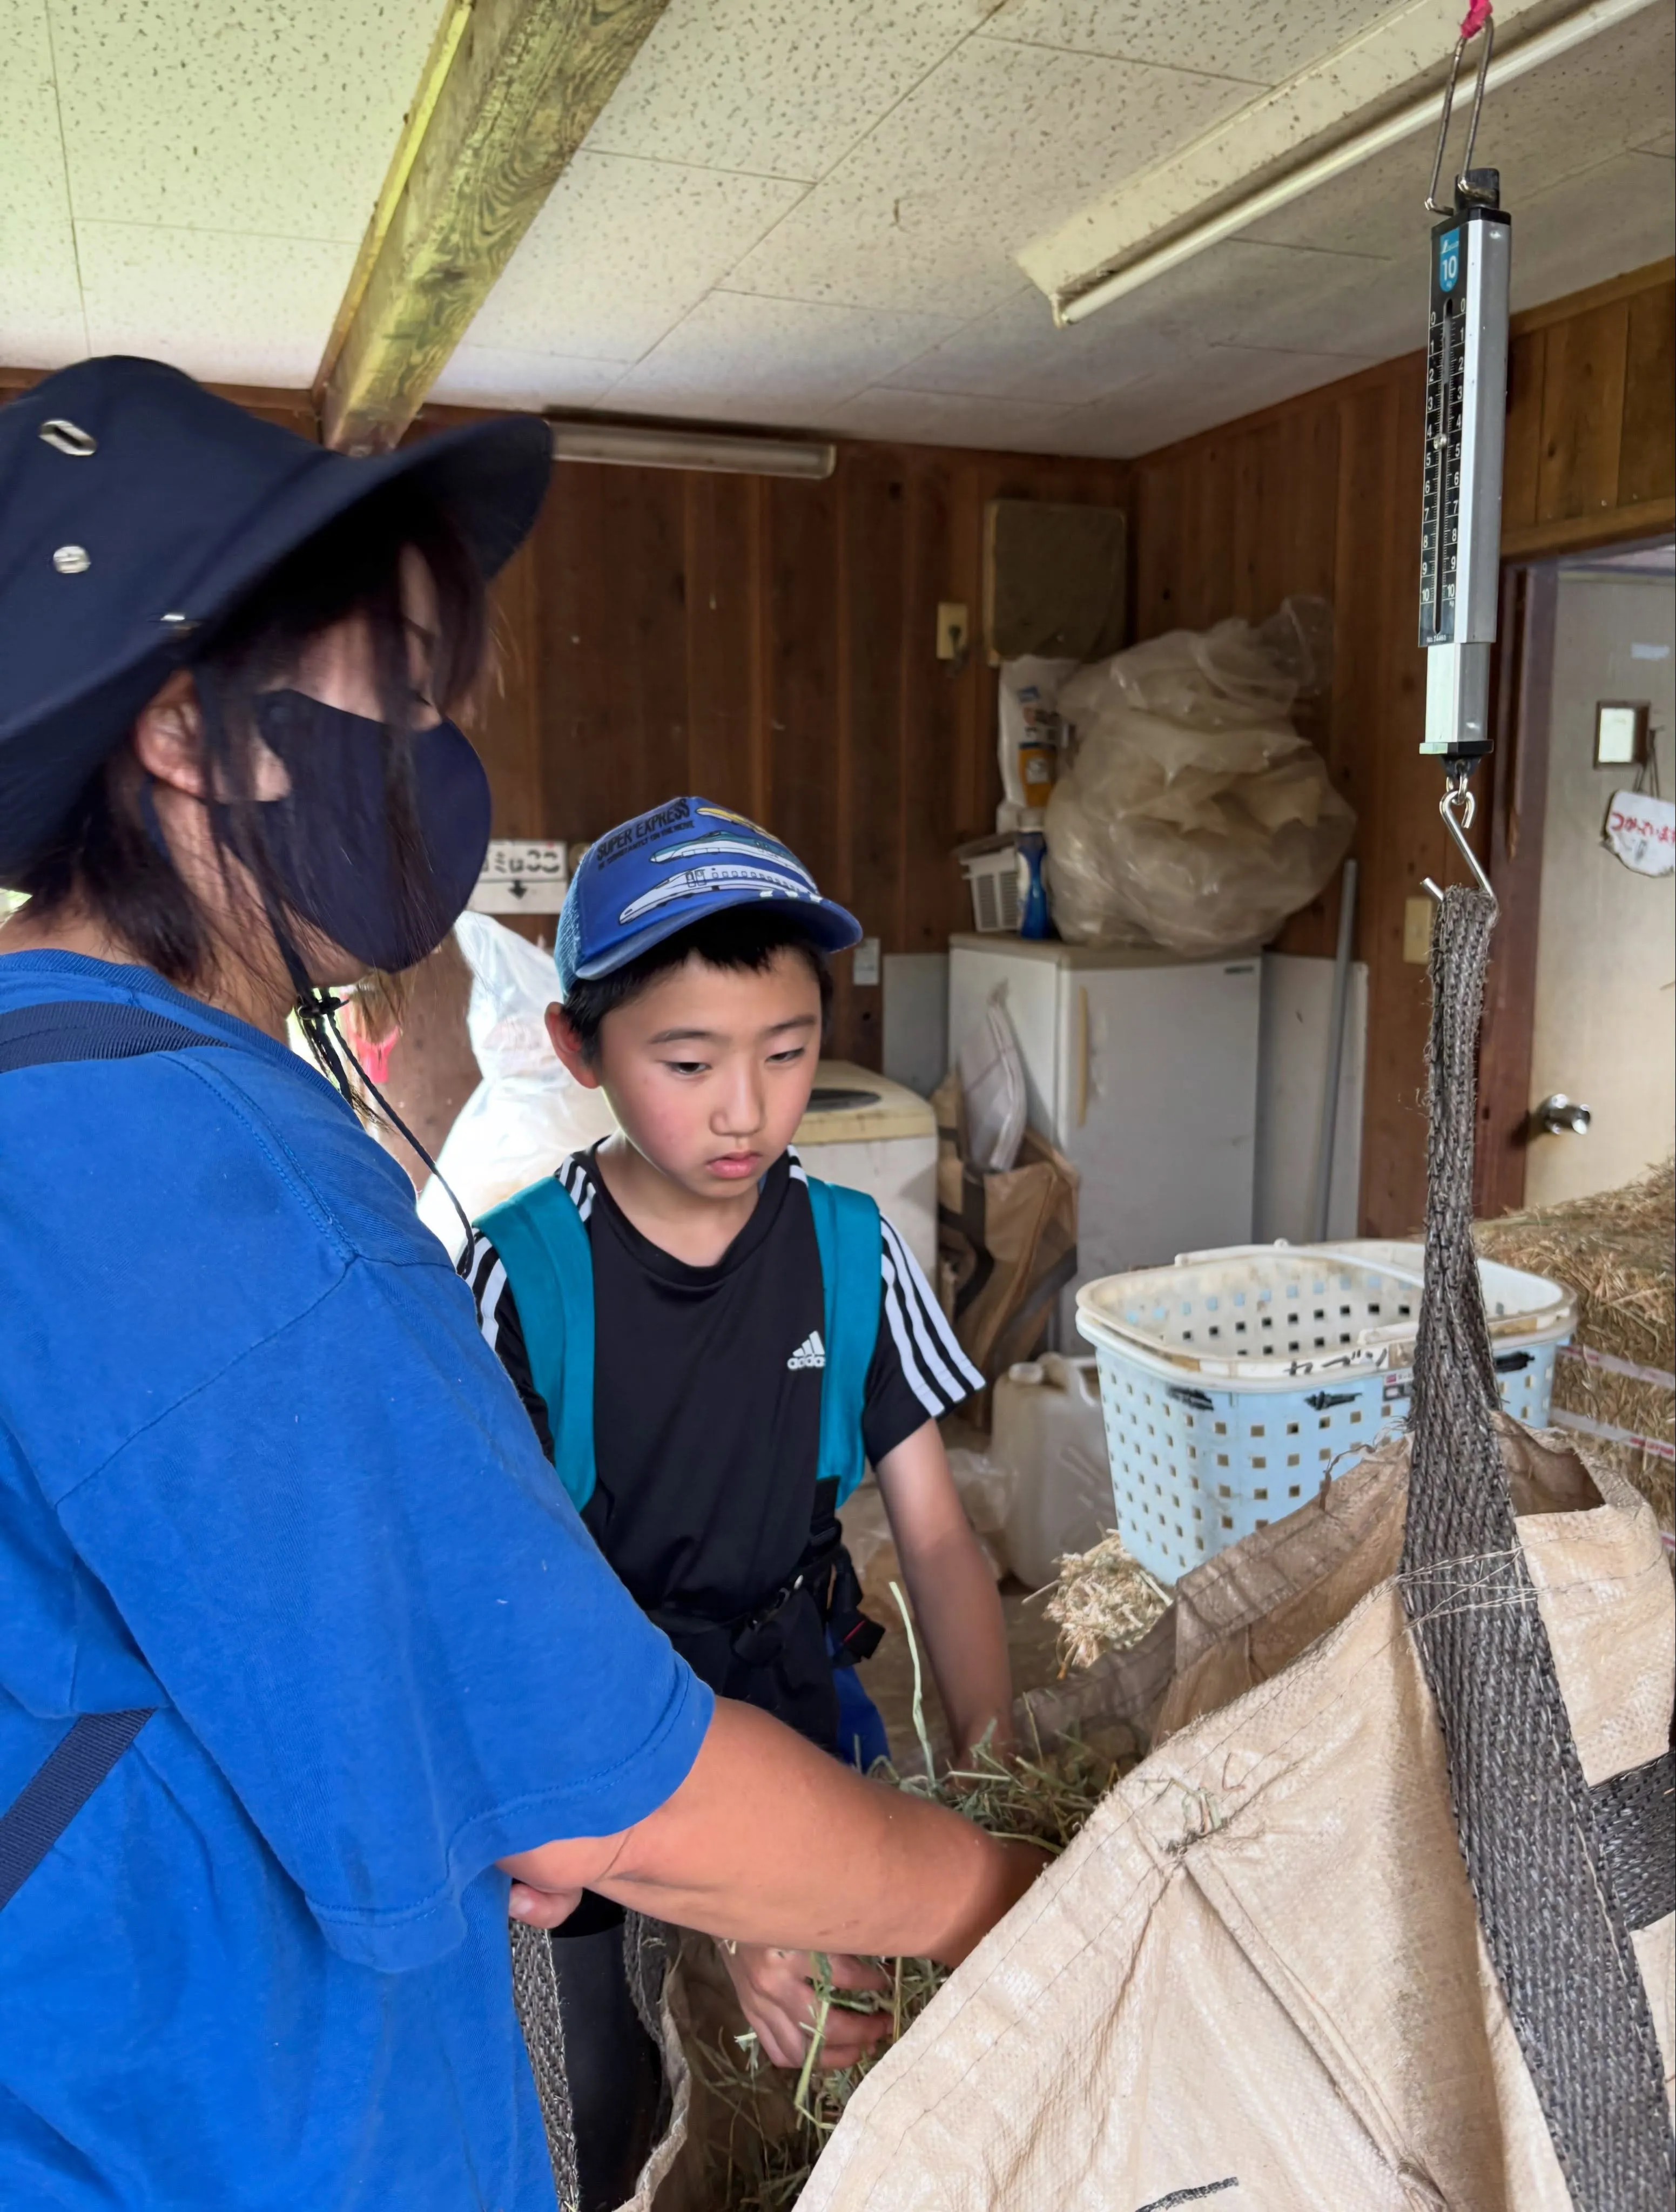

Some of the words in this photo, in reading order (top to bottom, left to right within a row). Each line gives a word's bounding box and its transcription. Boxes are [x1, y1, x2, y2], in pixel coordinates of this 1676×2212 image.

[1443, 255, 1457, 281] 10
[1460, 298, 1465, 312] 0
[1431, 312, 1436, 325] 0
[1460, 327, 1464, 341] 1
[1430, 339, 1434, 354] 1
[1458, 356, 1463, 370] 2
[1429, 368, 1434, 382] 2
[1457, 385, 1462, 400] 3
[1428, 396, 1433, 410] 3
[1456, 414, 1461, 428] 4
[1427, 424, 1432, 438] 4
[1455, 443, 1460, 457] 5
[1426, 453, 1431, 466] 5
[1454, 471, 1459, 485] 6
[1425, 480, 1430, 494] 6
[1453, 500, 1458, 514] 7
[1424, 508, 1429, 521] 7
[1423, 535, 1428, 548] 8
[1452, 528, 1457, 542] 8
[1423, 562, 1427, 575] 9
[1451, 556, 1456, 570] 9
[1422, 588, 1430, 602] 10
[1448, 584, 1455, 597] 10
[597, 828, 632, 861] SUPER
[636, 798, 690, 838] EXPRESS
[786, 1354, 826, 1371] adida
